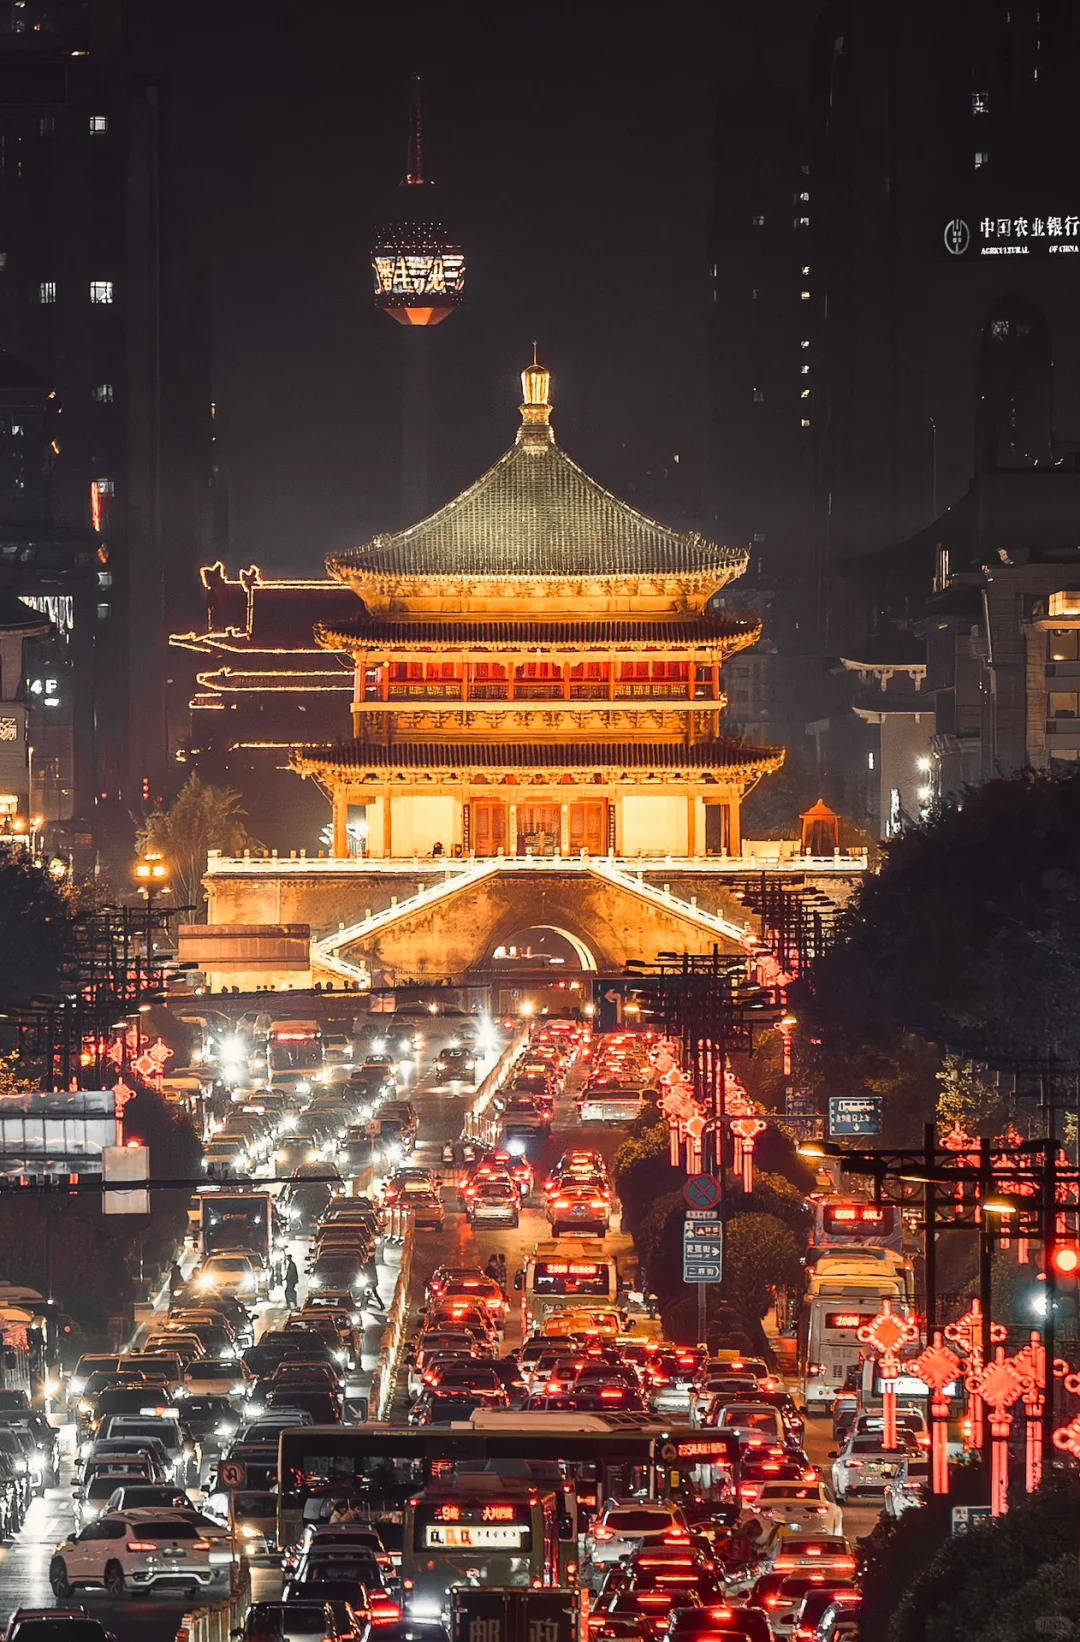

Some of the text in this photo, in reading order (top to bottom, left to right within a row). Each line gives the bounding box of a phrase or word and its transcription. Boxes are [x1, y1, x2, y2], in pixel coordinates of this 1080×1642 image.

[980, 216, 1080, 238] 中国农业银行
